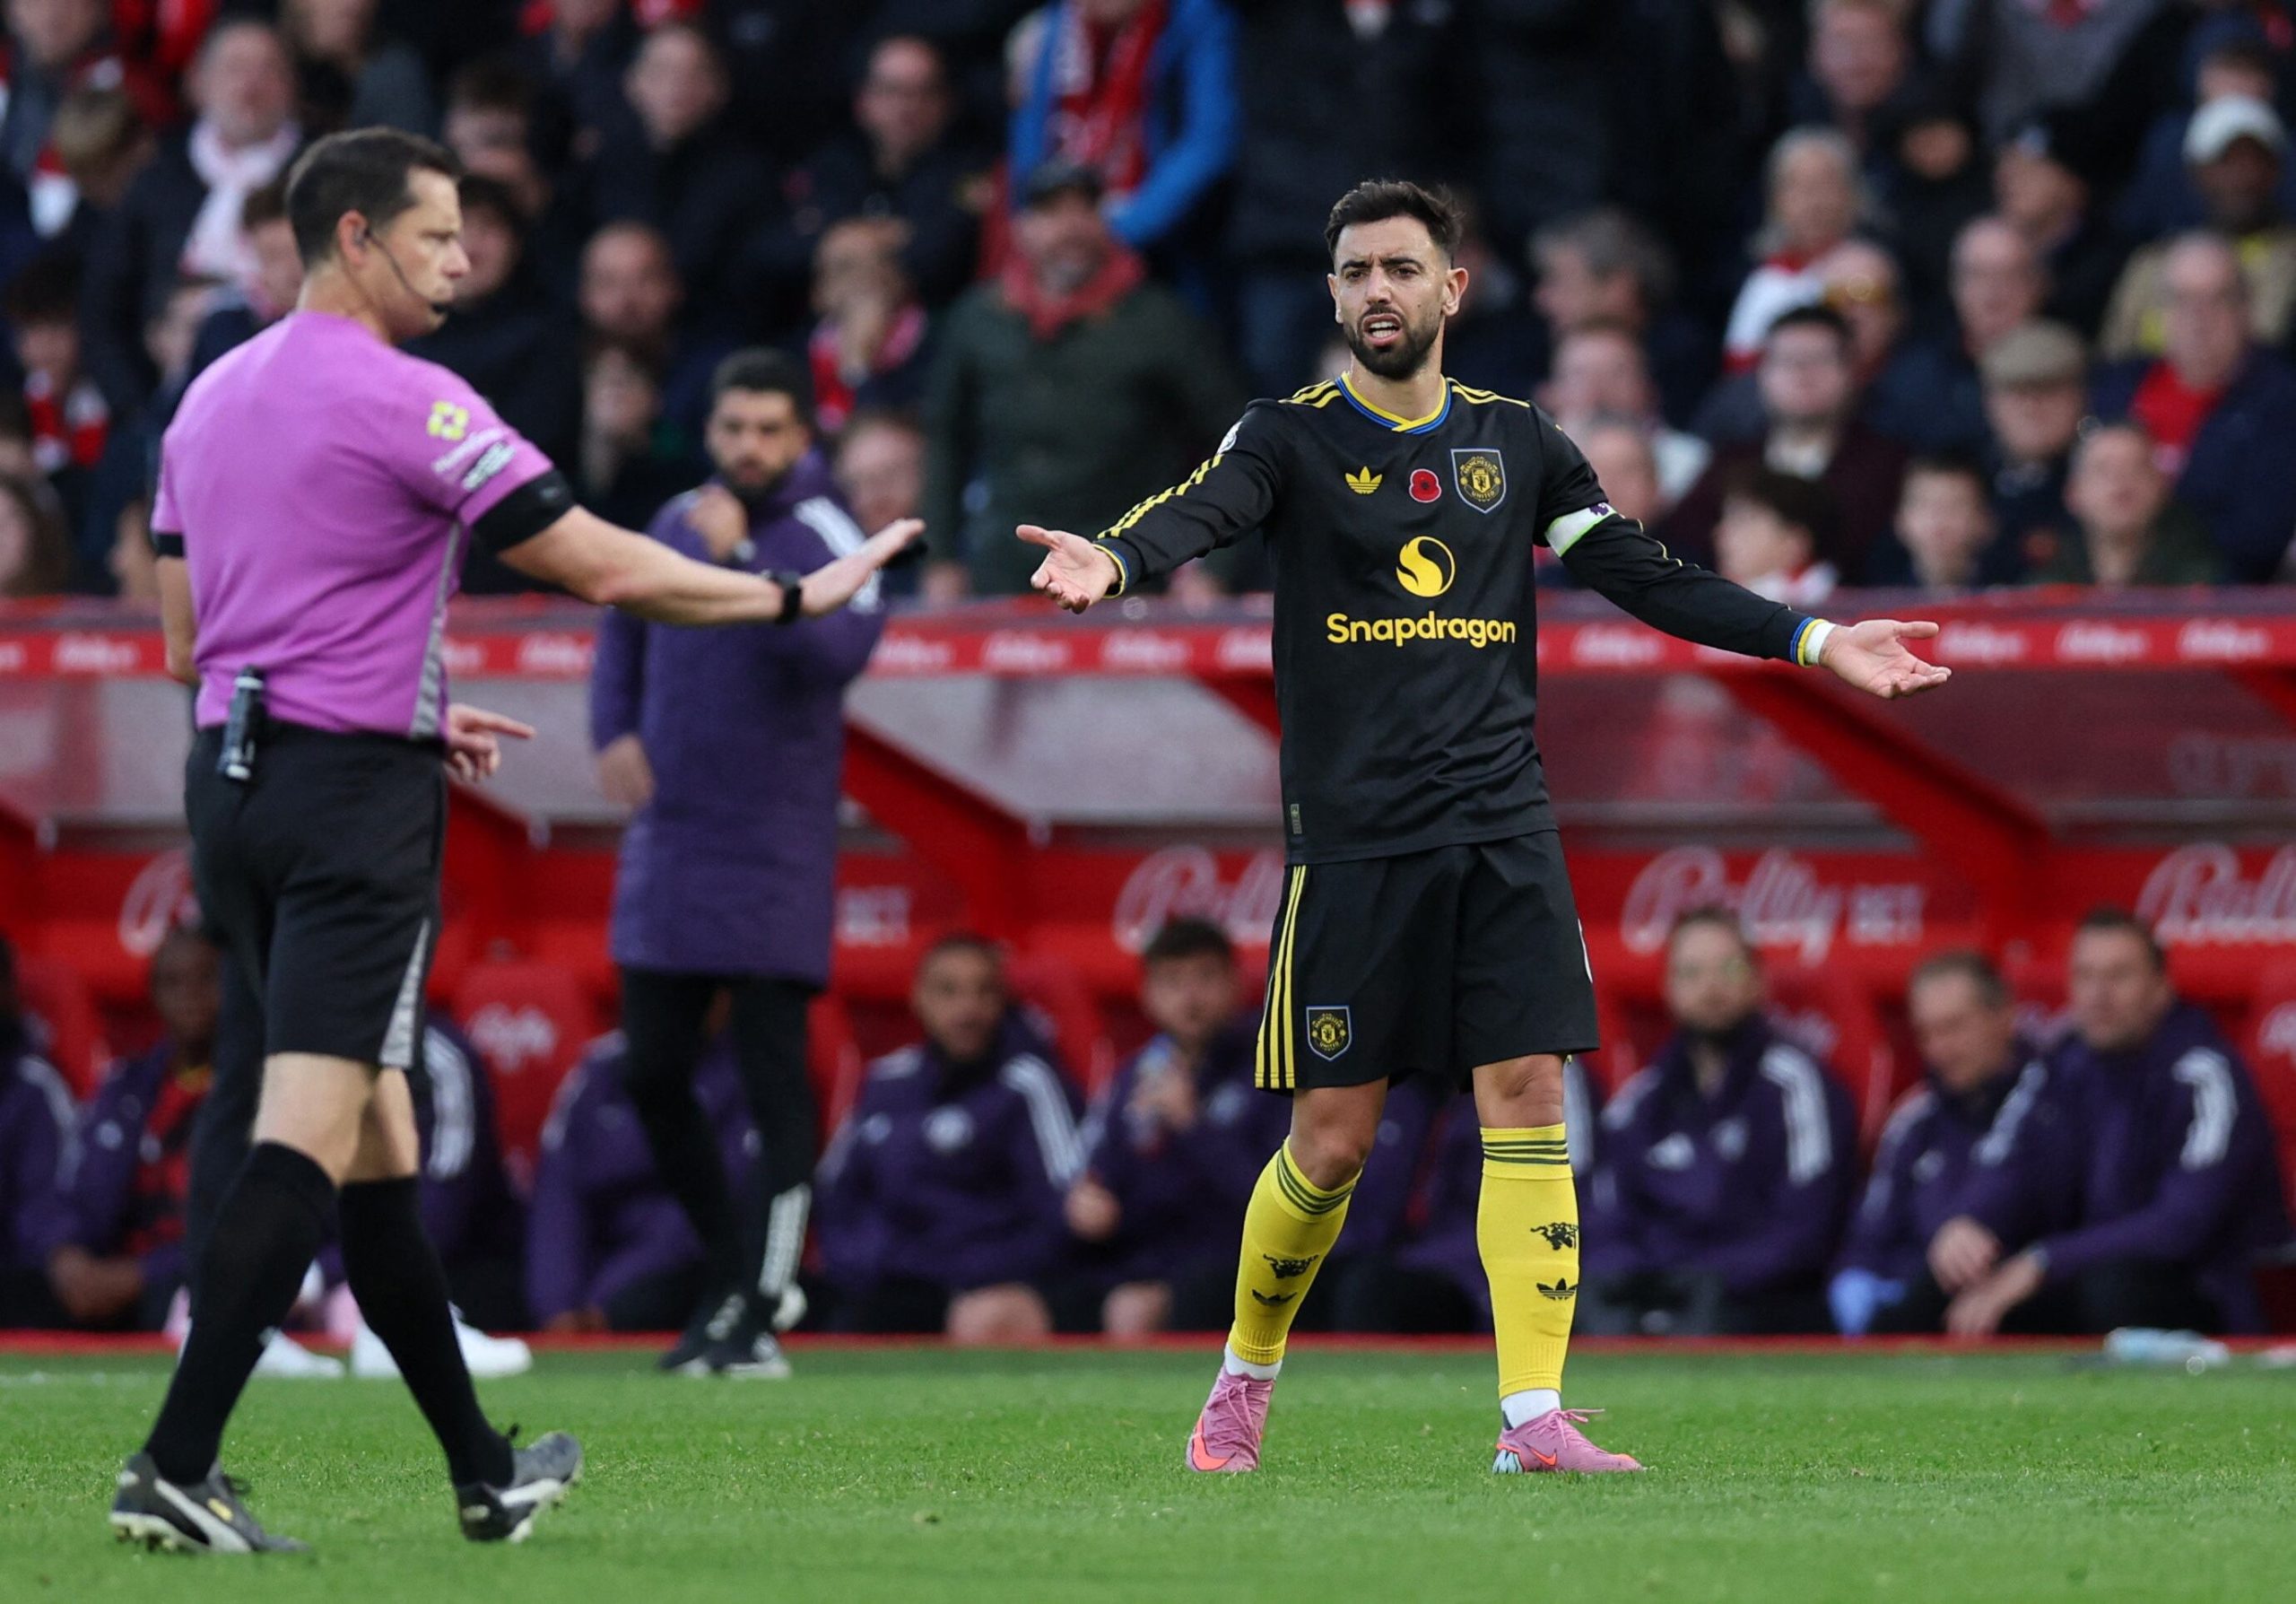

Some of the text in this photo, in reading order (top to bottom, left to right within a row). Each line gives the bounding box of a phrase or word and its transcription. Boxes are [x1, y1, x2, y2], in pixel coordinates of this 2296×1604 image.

[1472, 489, 1495, 499] UNITED
[1326, 610, 1516, 649] Snapdragon
[1621, 846, 1925, 968] Blly BET
